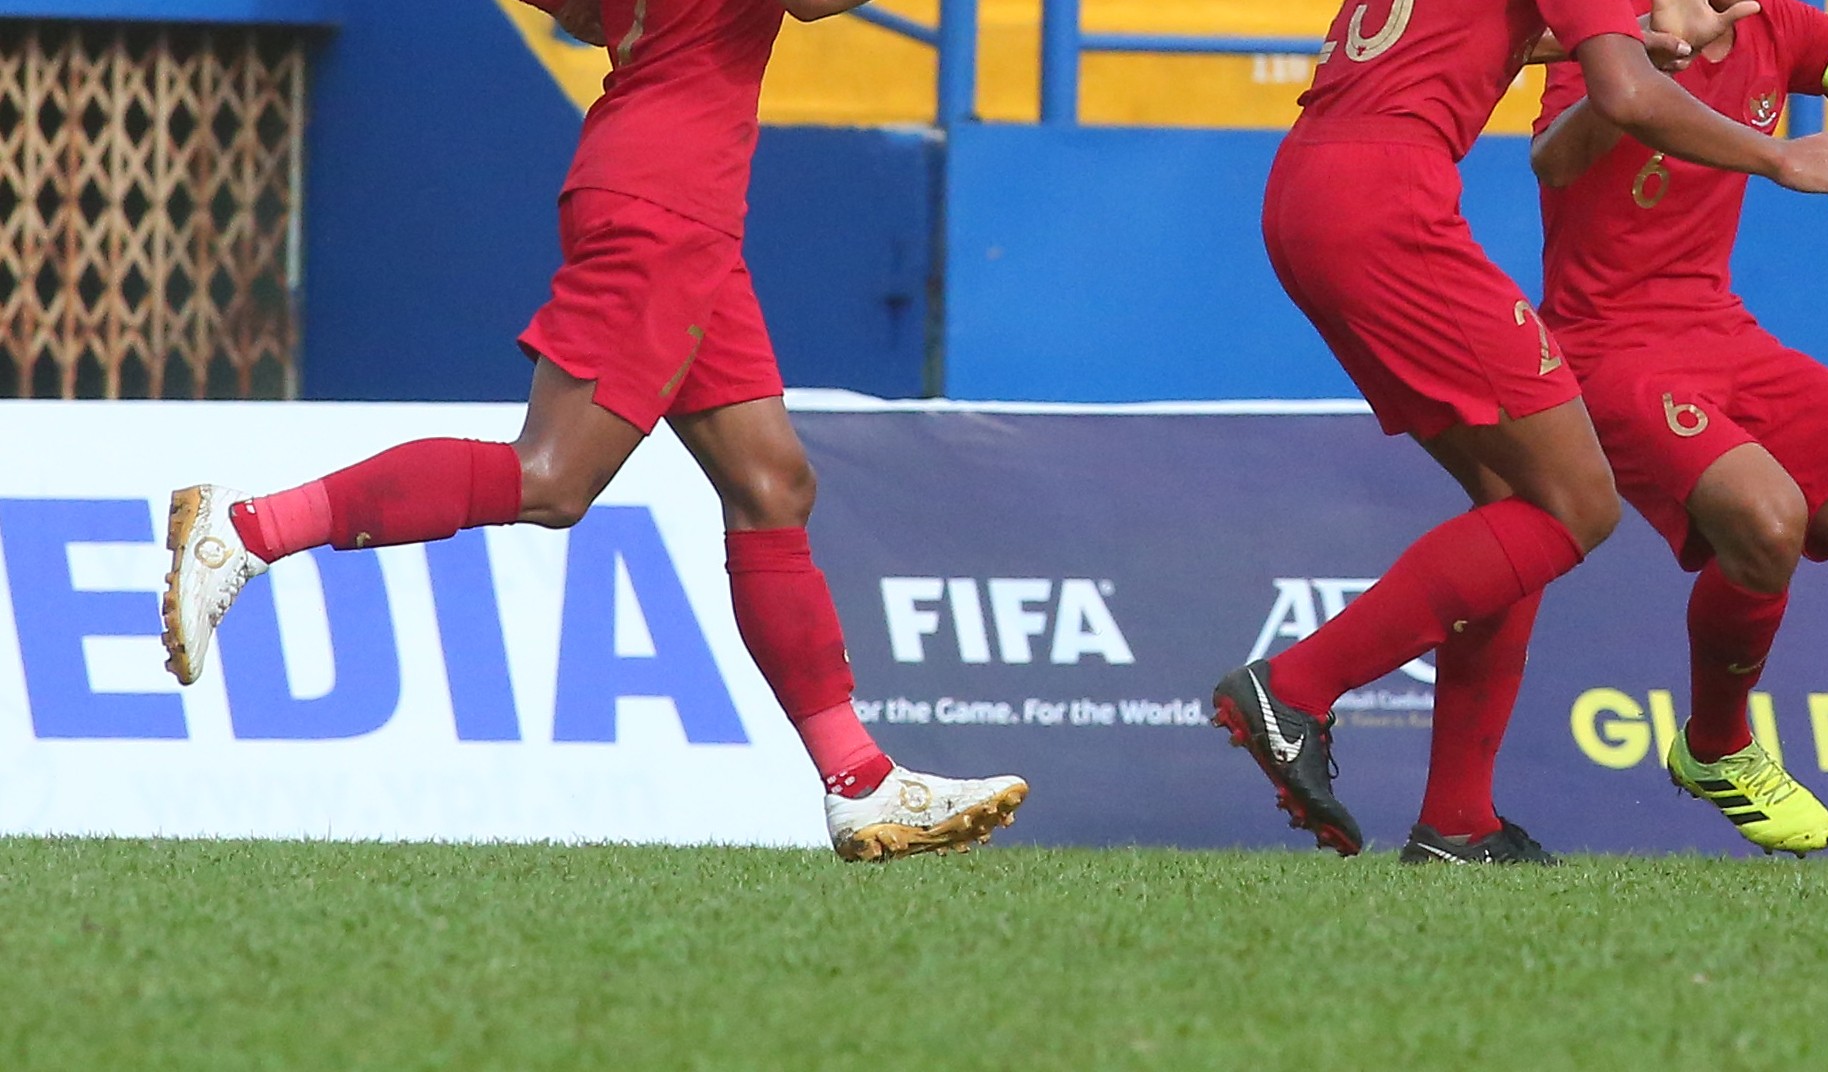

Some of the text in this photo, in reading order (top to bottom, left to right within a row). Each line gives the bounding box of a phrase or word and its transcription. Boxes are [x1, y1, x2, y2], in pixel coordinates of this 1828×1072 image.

[1632, 150, 1670, 209] 6
[1662, 392, 1709, 437] 6
[880, 576, 1135, 665] FIFA
[886, 696, 931, 725] the
[935, 696, 1019, 726] Game.
[1022, 697, 1068, 726] For
[1070, 697, 1116, 726] the
[1119, 697, 1209, 727] World.
